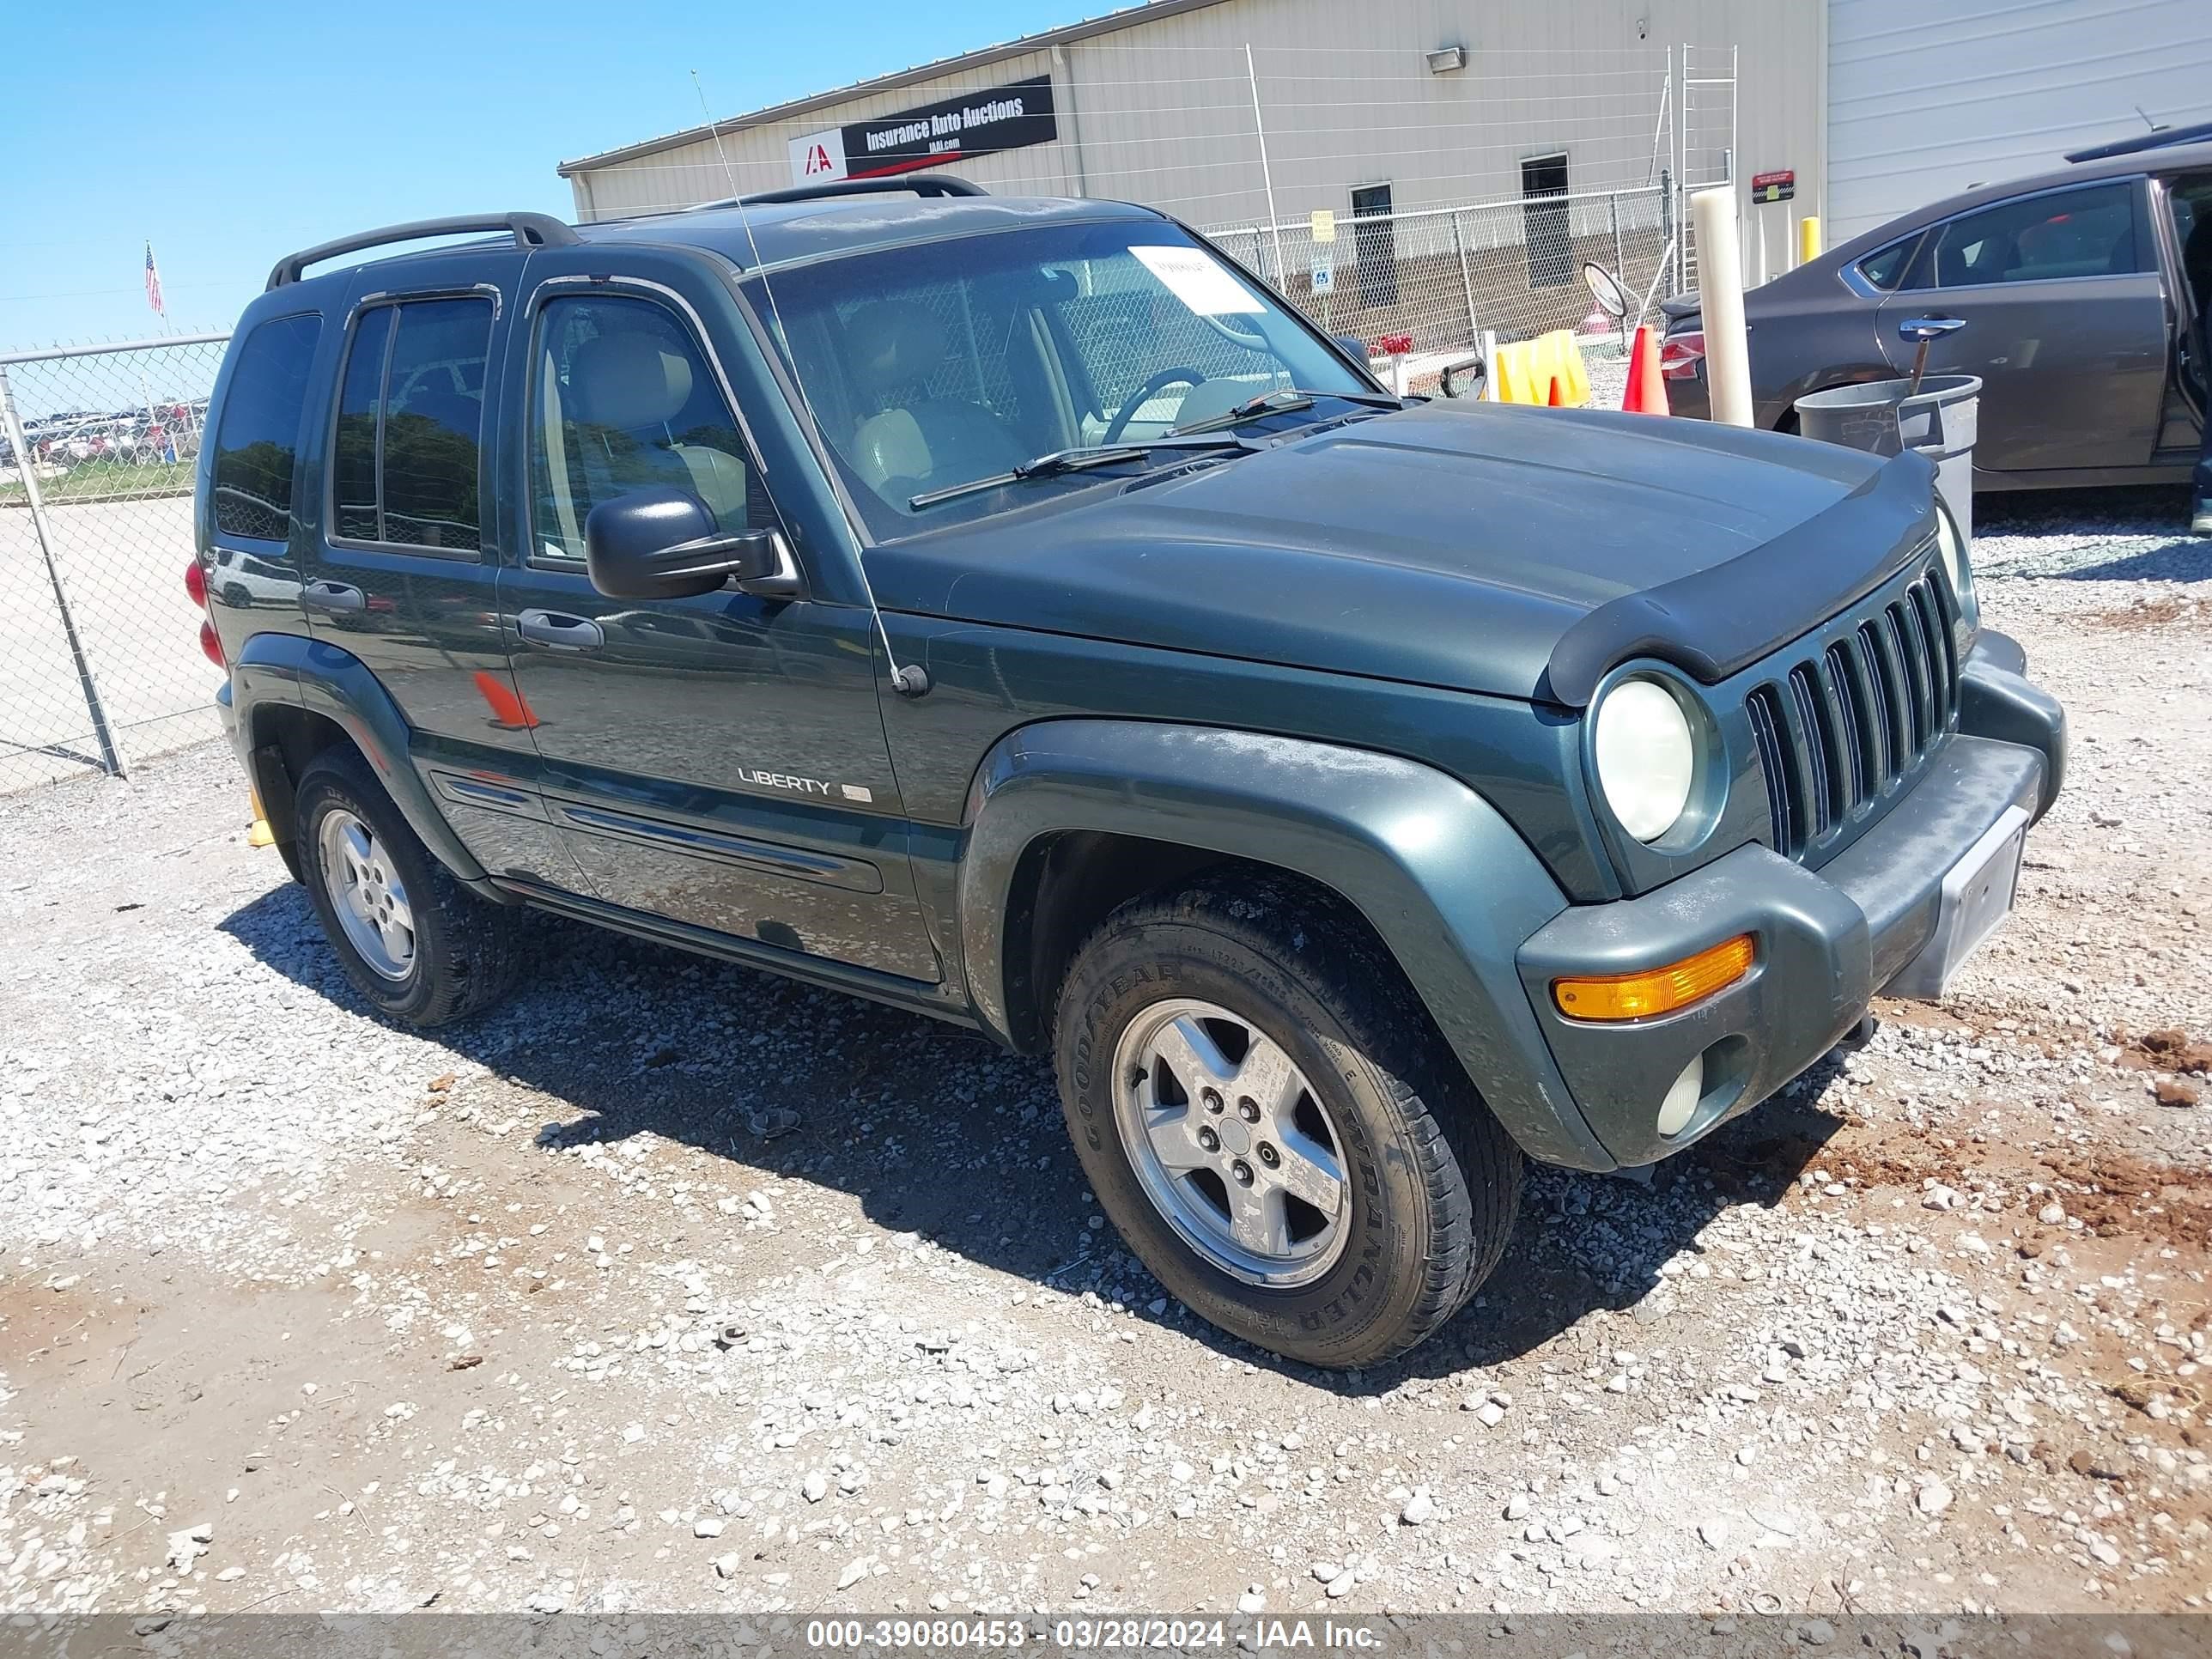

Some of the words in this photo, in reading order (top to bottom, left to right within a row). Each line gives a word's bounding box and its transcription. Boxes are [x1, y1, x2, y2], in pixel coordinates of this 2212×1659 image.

[866, 120, 930, 151] Insurance
[931, 112, 961, 137] Auto
[963, 97, 1024, 130] Auctions
[737, 767, 831, 796] LIBERTY
[1075, 961, 1182, 1152] GOODYEAR
[1297, 1106, 1388, 1332] WRANGLER
